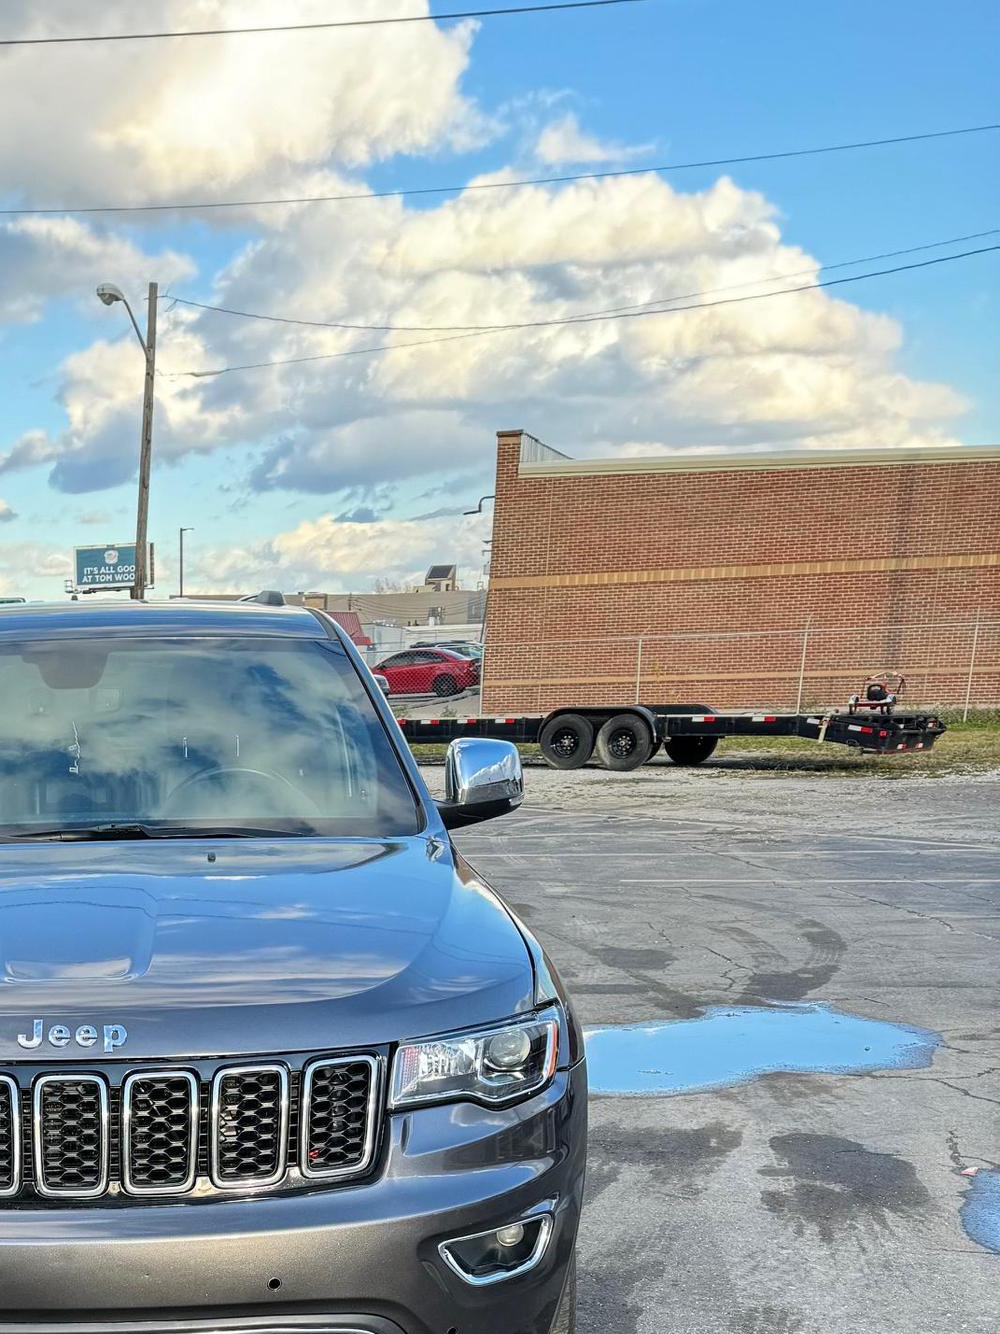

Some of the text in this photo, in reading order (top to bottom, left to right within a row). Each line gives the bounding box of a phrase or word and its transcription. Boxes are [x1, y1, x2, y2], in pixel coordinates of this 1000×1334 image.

[82, 575, 93, 583] AT
[95, 574, 112, 582] TOM
[17, 1019, 128, 1053] Jeep
